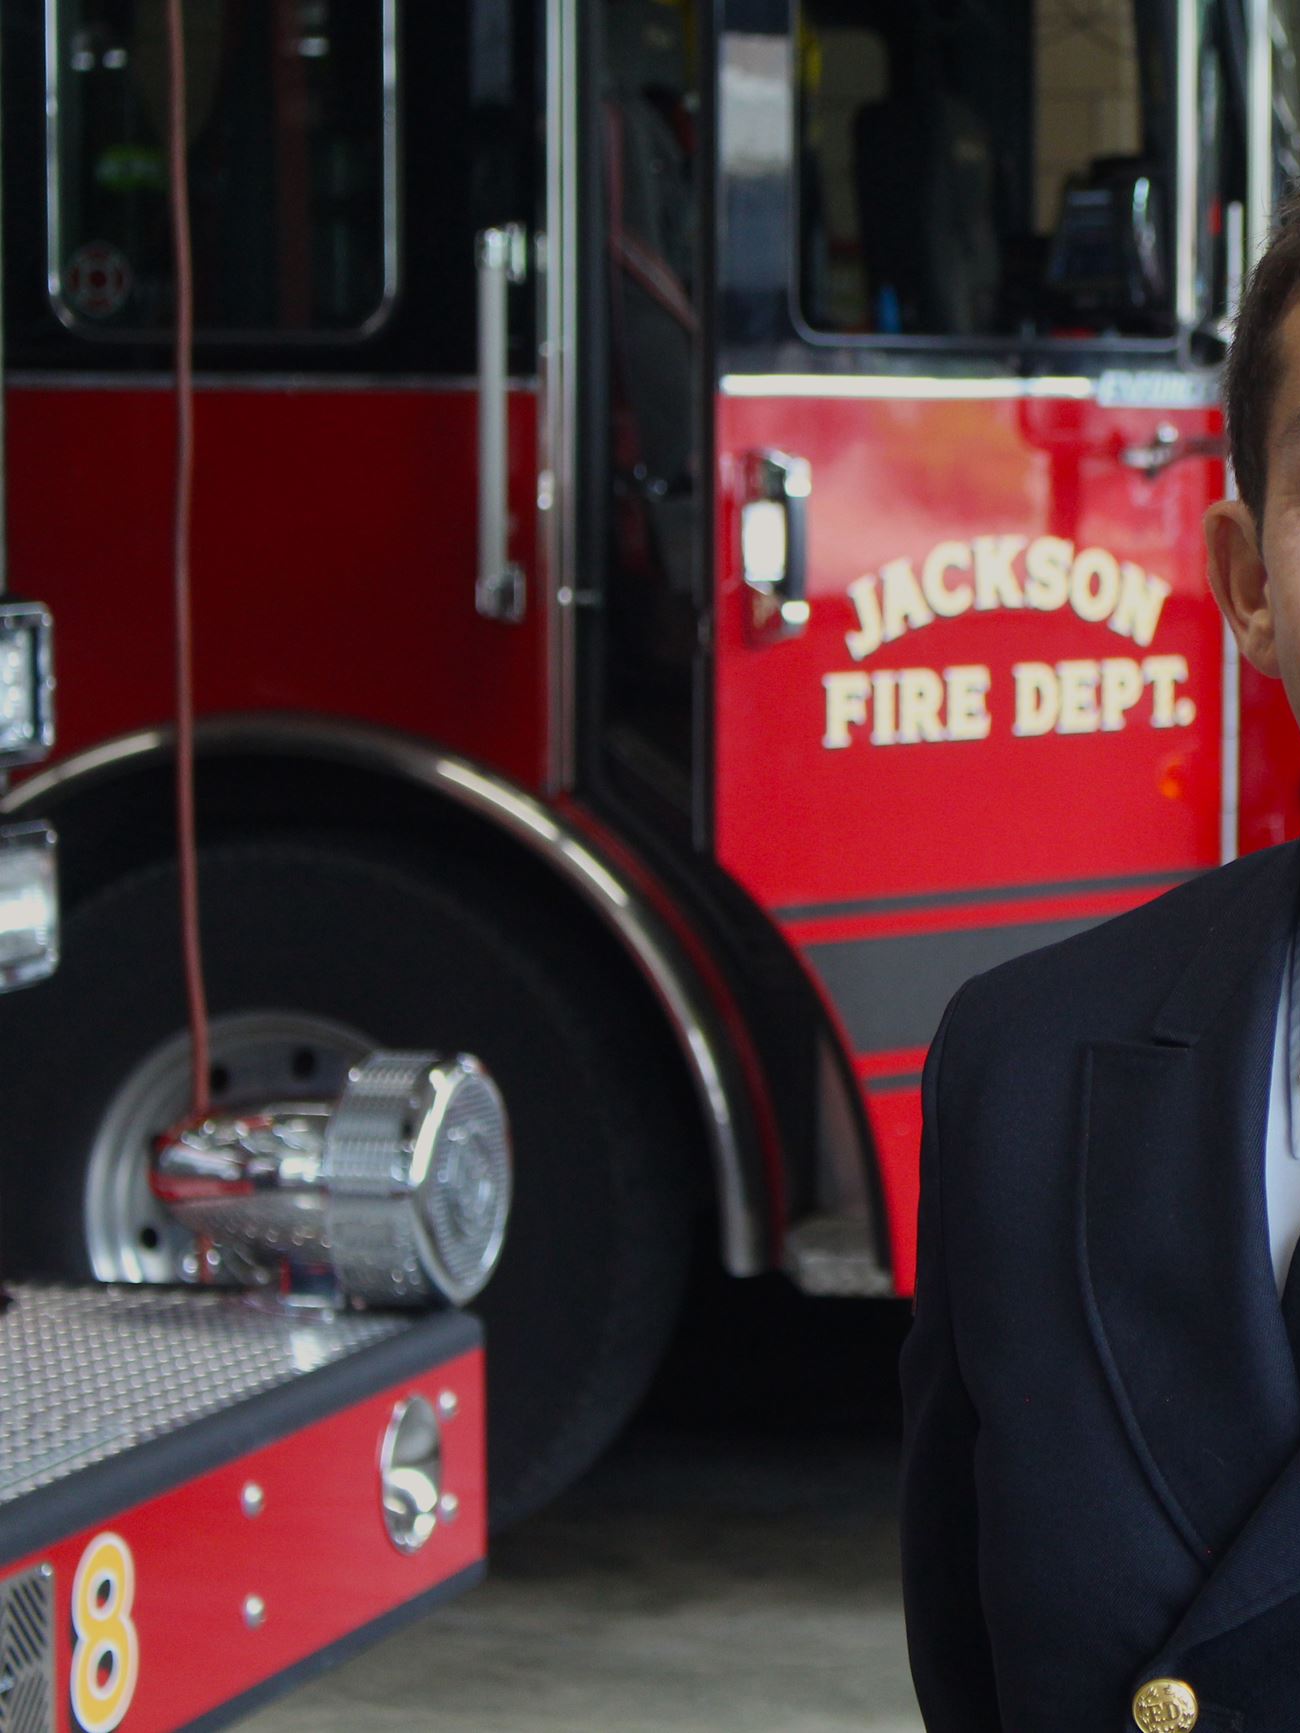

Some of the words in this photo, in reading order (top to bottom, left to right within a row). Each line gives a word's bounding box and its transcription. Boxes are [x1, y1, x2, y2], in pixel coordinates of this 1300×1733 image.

[845, 535, 1171, 661] JACKSON
[821, 665, 992, 750] FIRE
[1011, 654, 1196, 737] DEPT.
[71, 1531, 139, 1733] 8
